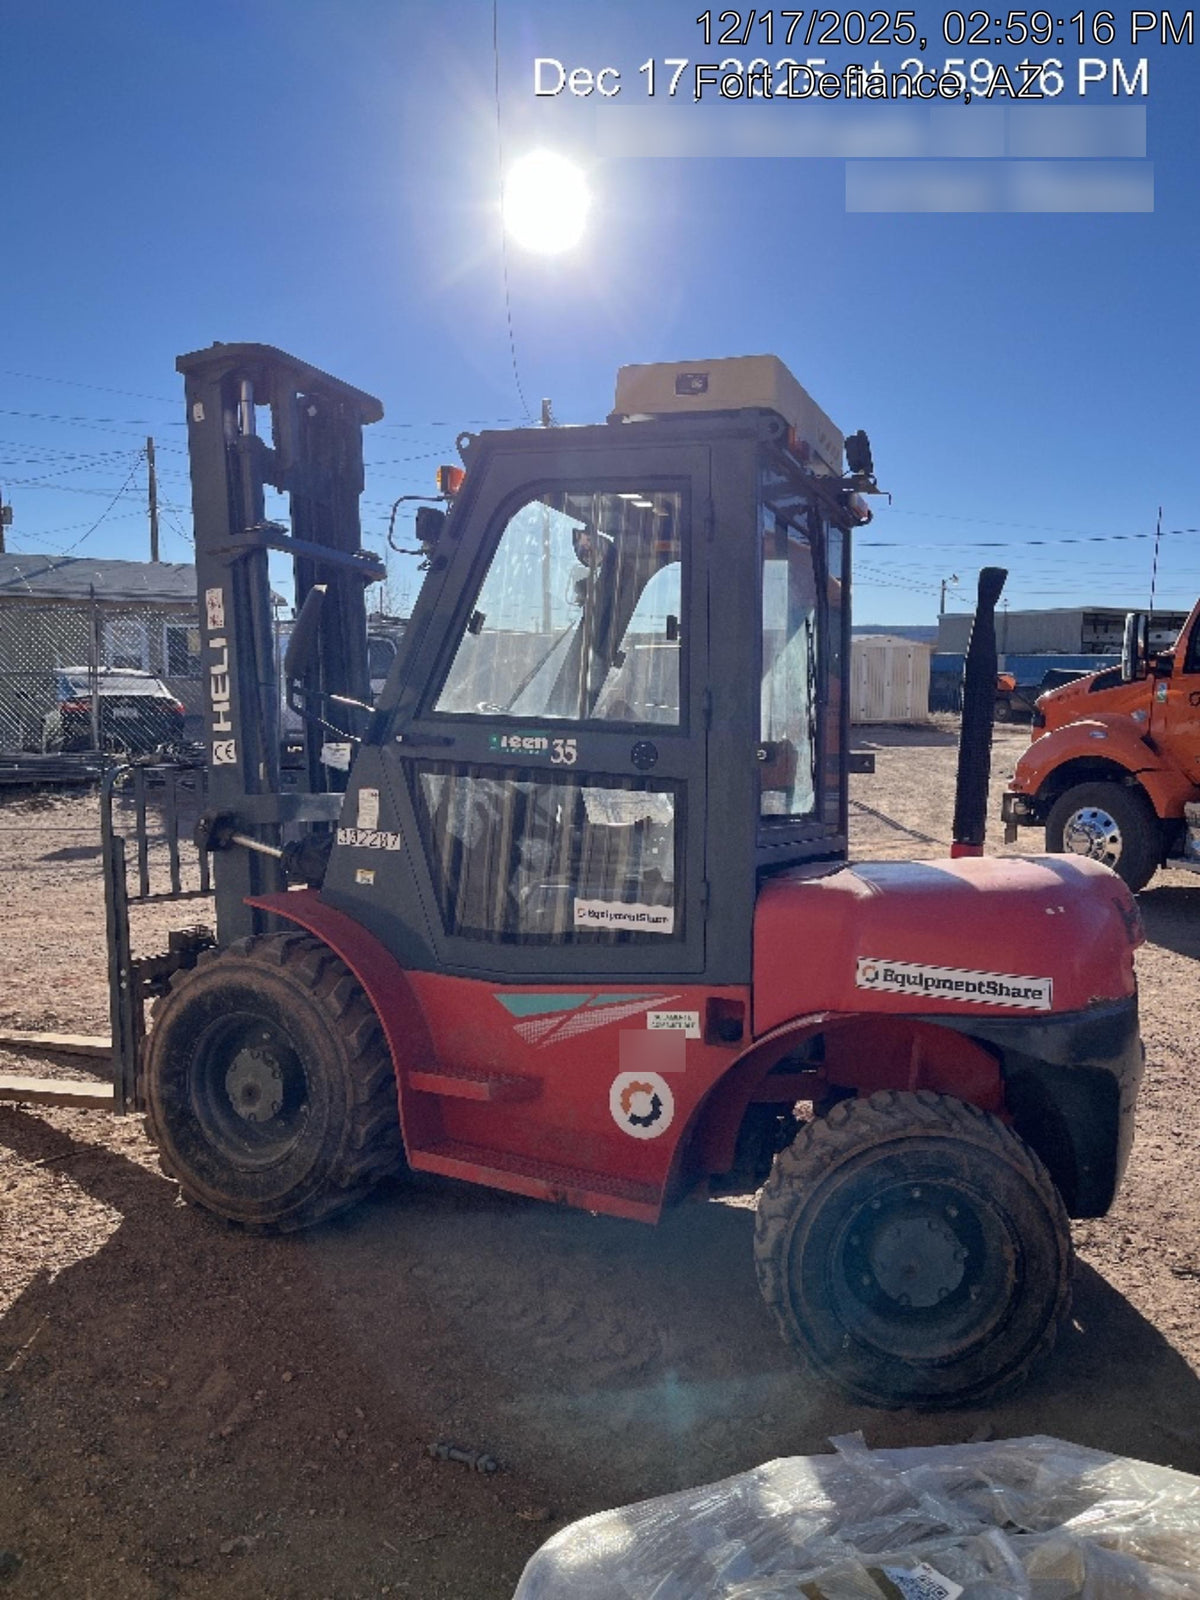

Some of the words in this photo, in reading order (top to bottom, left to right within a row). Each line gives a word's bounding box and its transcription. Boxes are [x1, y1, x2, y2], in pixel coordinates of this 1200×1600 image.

[208, 637, 232, 732] HELI
[550, 738, 577, 765] 35
[882, 967, 1044, 1001] EquipmentShare
